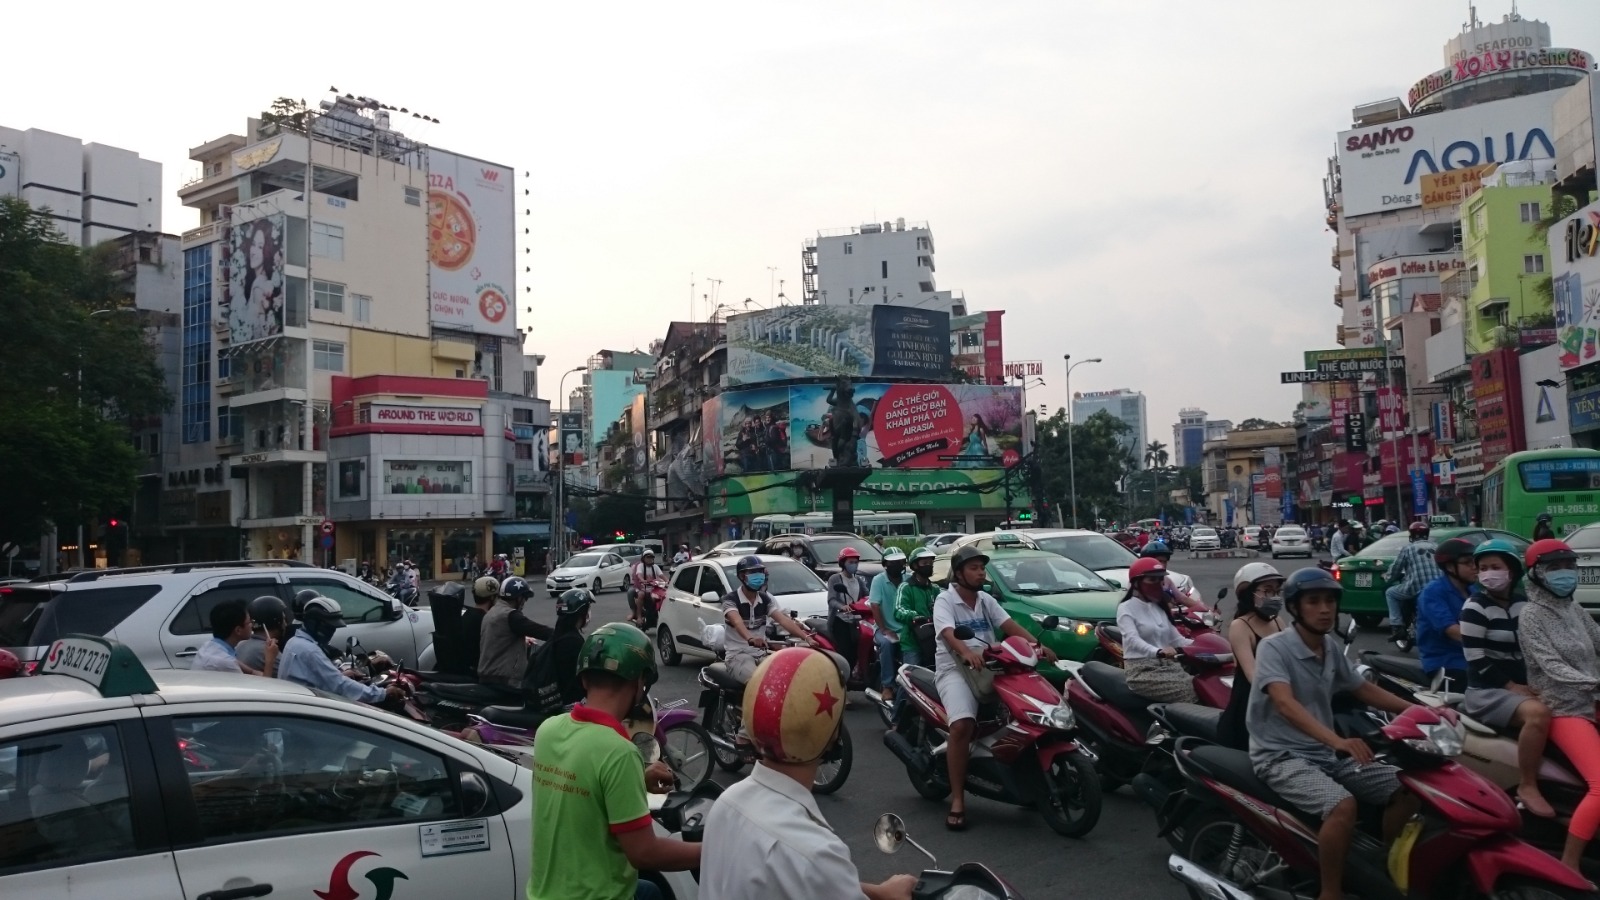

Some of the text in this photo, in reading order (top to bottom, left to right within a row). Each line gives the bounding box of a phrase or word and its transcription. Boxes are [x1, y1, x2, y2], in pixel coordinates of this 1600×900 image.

[1476, 36, 1532, 55] SEAFOOD
[1454, 50, 1512, 81] XOAY
[1513, 49, 1567, 68] Hoàng
[1346, 126, 1414, 152] SANYO
[1404, 128, 1556, 185] AQUA
[1382, 193, 1412, 206] Dòng
[1401, 261, 1426, 274] Coffee
[1429, 260, 1435, 272] &
[1437, 259, 1449, 271] Ice
[897, 341, 937, 352] VINHOMES
[887, 350, 944, 363] GOLDEN RIVER
[892, 389, 940, 409] CẢ THẾ GIỚI
[1083, 390, 1121, 398] VIETBANK
[378, 409, 474, 422] AROUND THE WORLD
[885, 399, 946, 420] ĐANG CHỜ BẠN
[886, 408, 947, 430] KHÁM PHÁ VỚI
[903, 422, 935, 436] AIRASIA
[1349, 414, 1361, 447] HOTEL
[1547, 504, 1599, 515] 51B-205.82
[62, 645, 110, 676] 38.27 27 27
